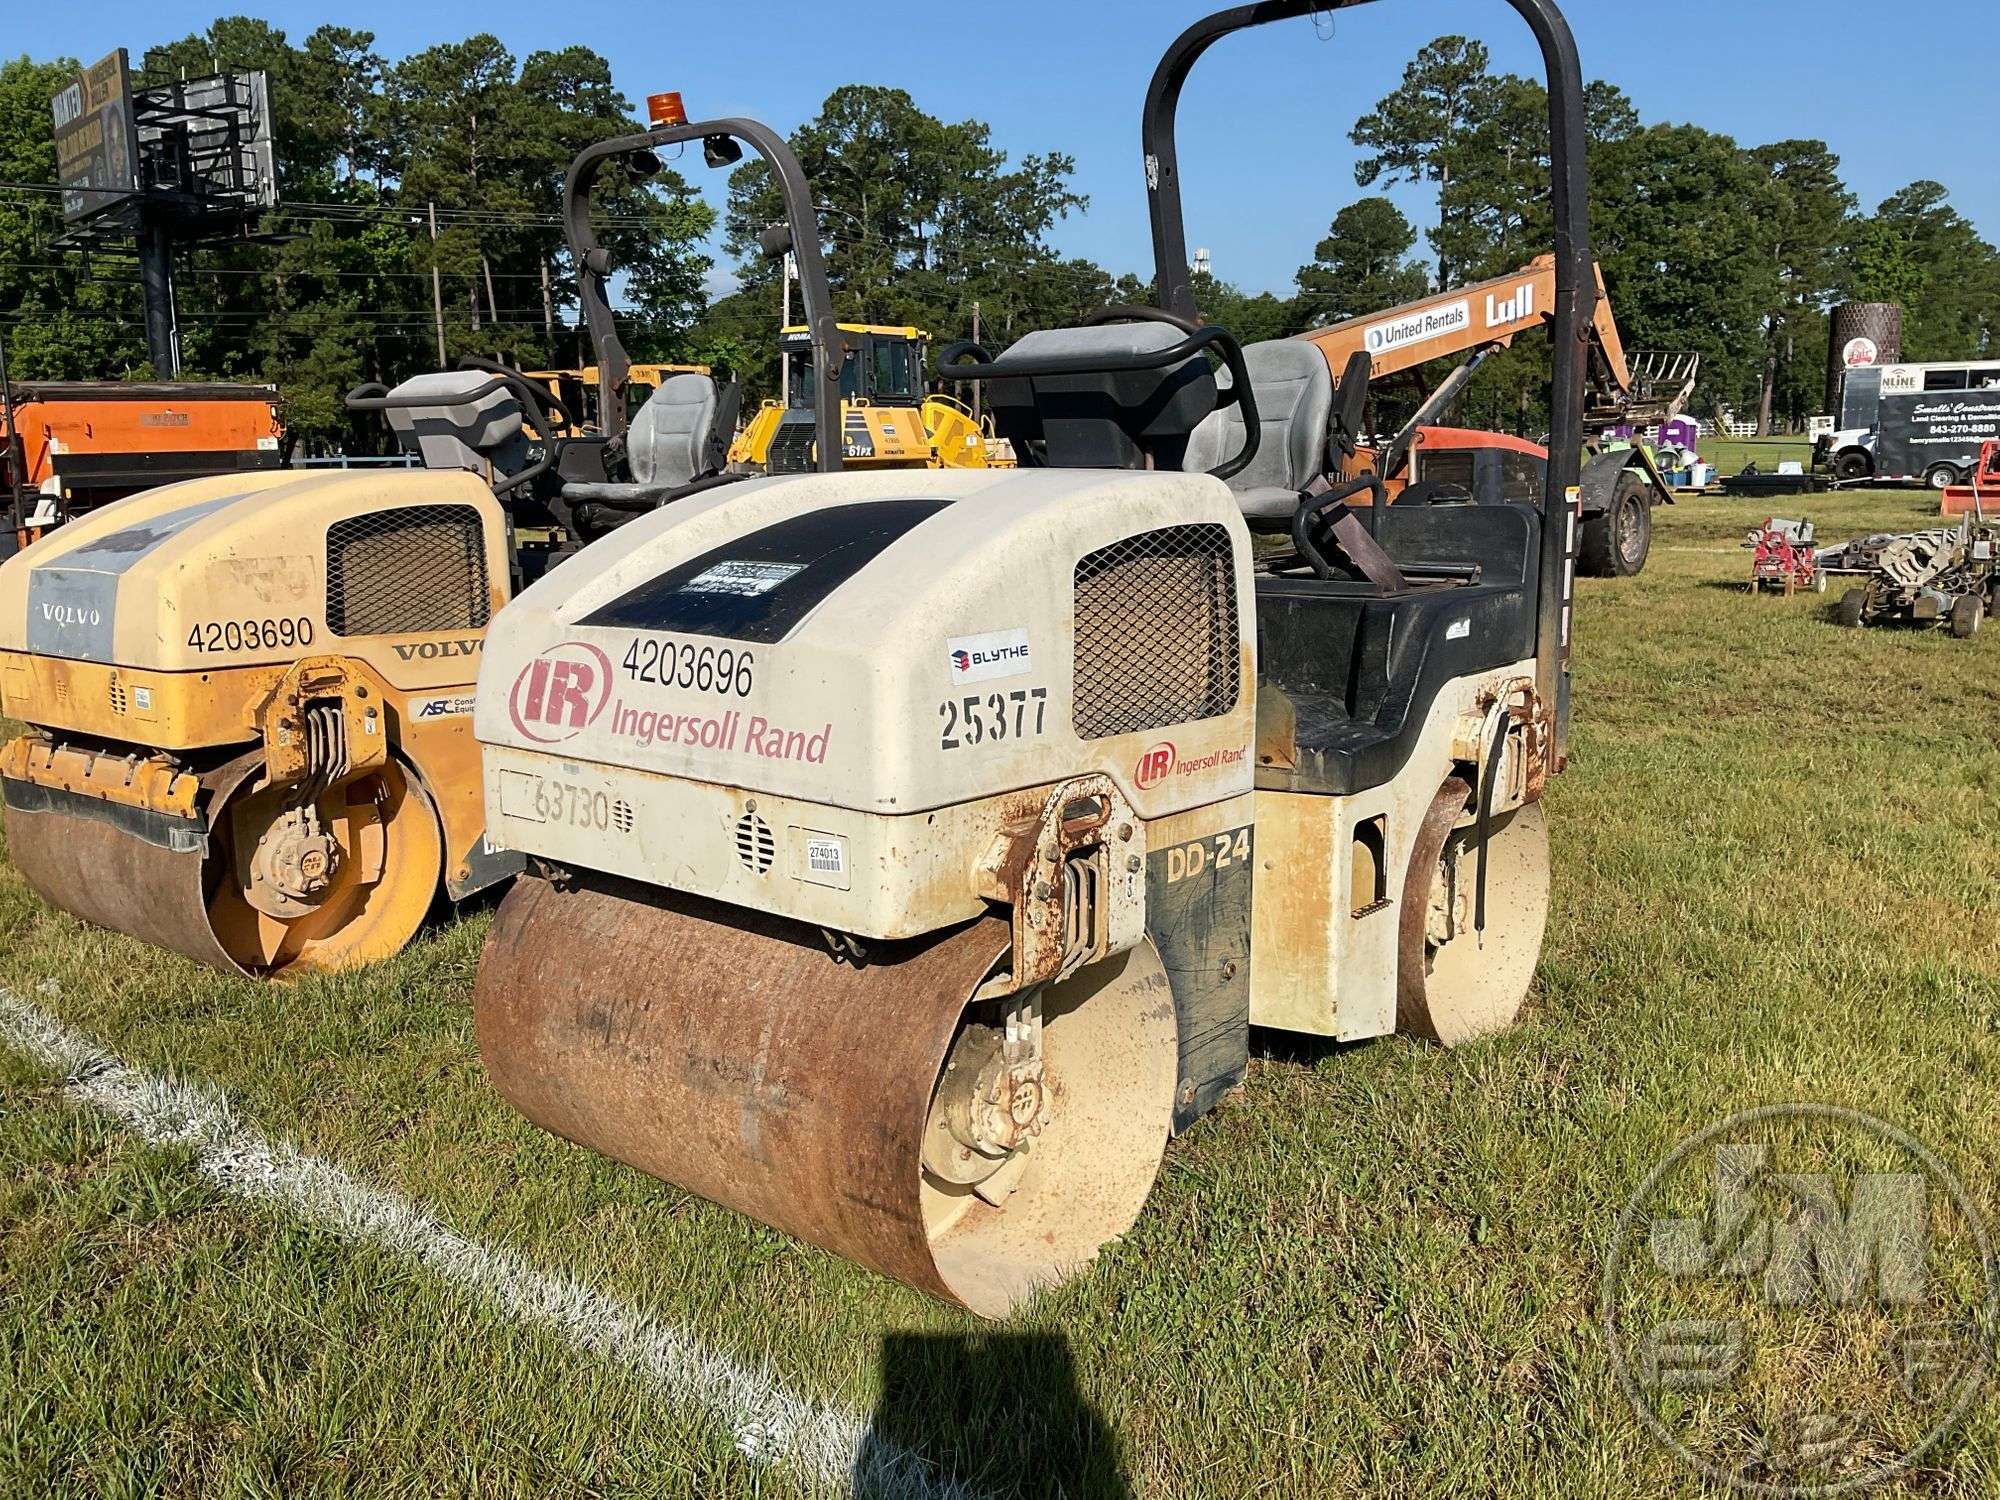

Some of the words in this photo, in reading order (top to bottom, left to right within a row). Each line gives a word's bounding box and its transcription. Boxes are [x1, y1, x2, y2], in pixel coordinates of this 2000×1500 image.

[1486, 283, 1533, 328] Lull
[787, 333, 811, 341] KOMA
[1385, 318, 1423, 343] United
[1425, 307, 1464, 332] Rentals
[1911, 415, 1929, 423] Land
[41, 602, 100, 626] VOLVO
[187, 617, 313, 653] 4203690
[622, 637, 755, 698] 4203696
[972, 644, 1030, 666] BLYTHE
[611, 699, 741, 751] Ingersoll
[744, 716, 832, 764] Rand
[939, 687, 1047, 750] 25377
[1176, 750, 1220, 776] Ingersoll
[809, 847, 839, 860] 274013
[1166, 828, 1250, 885] DD-24
